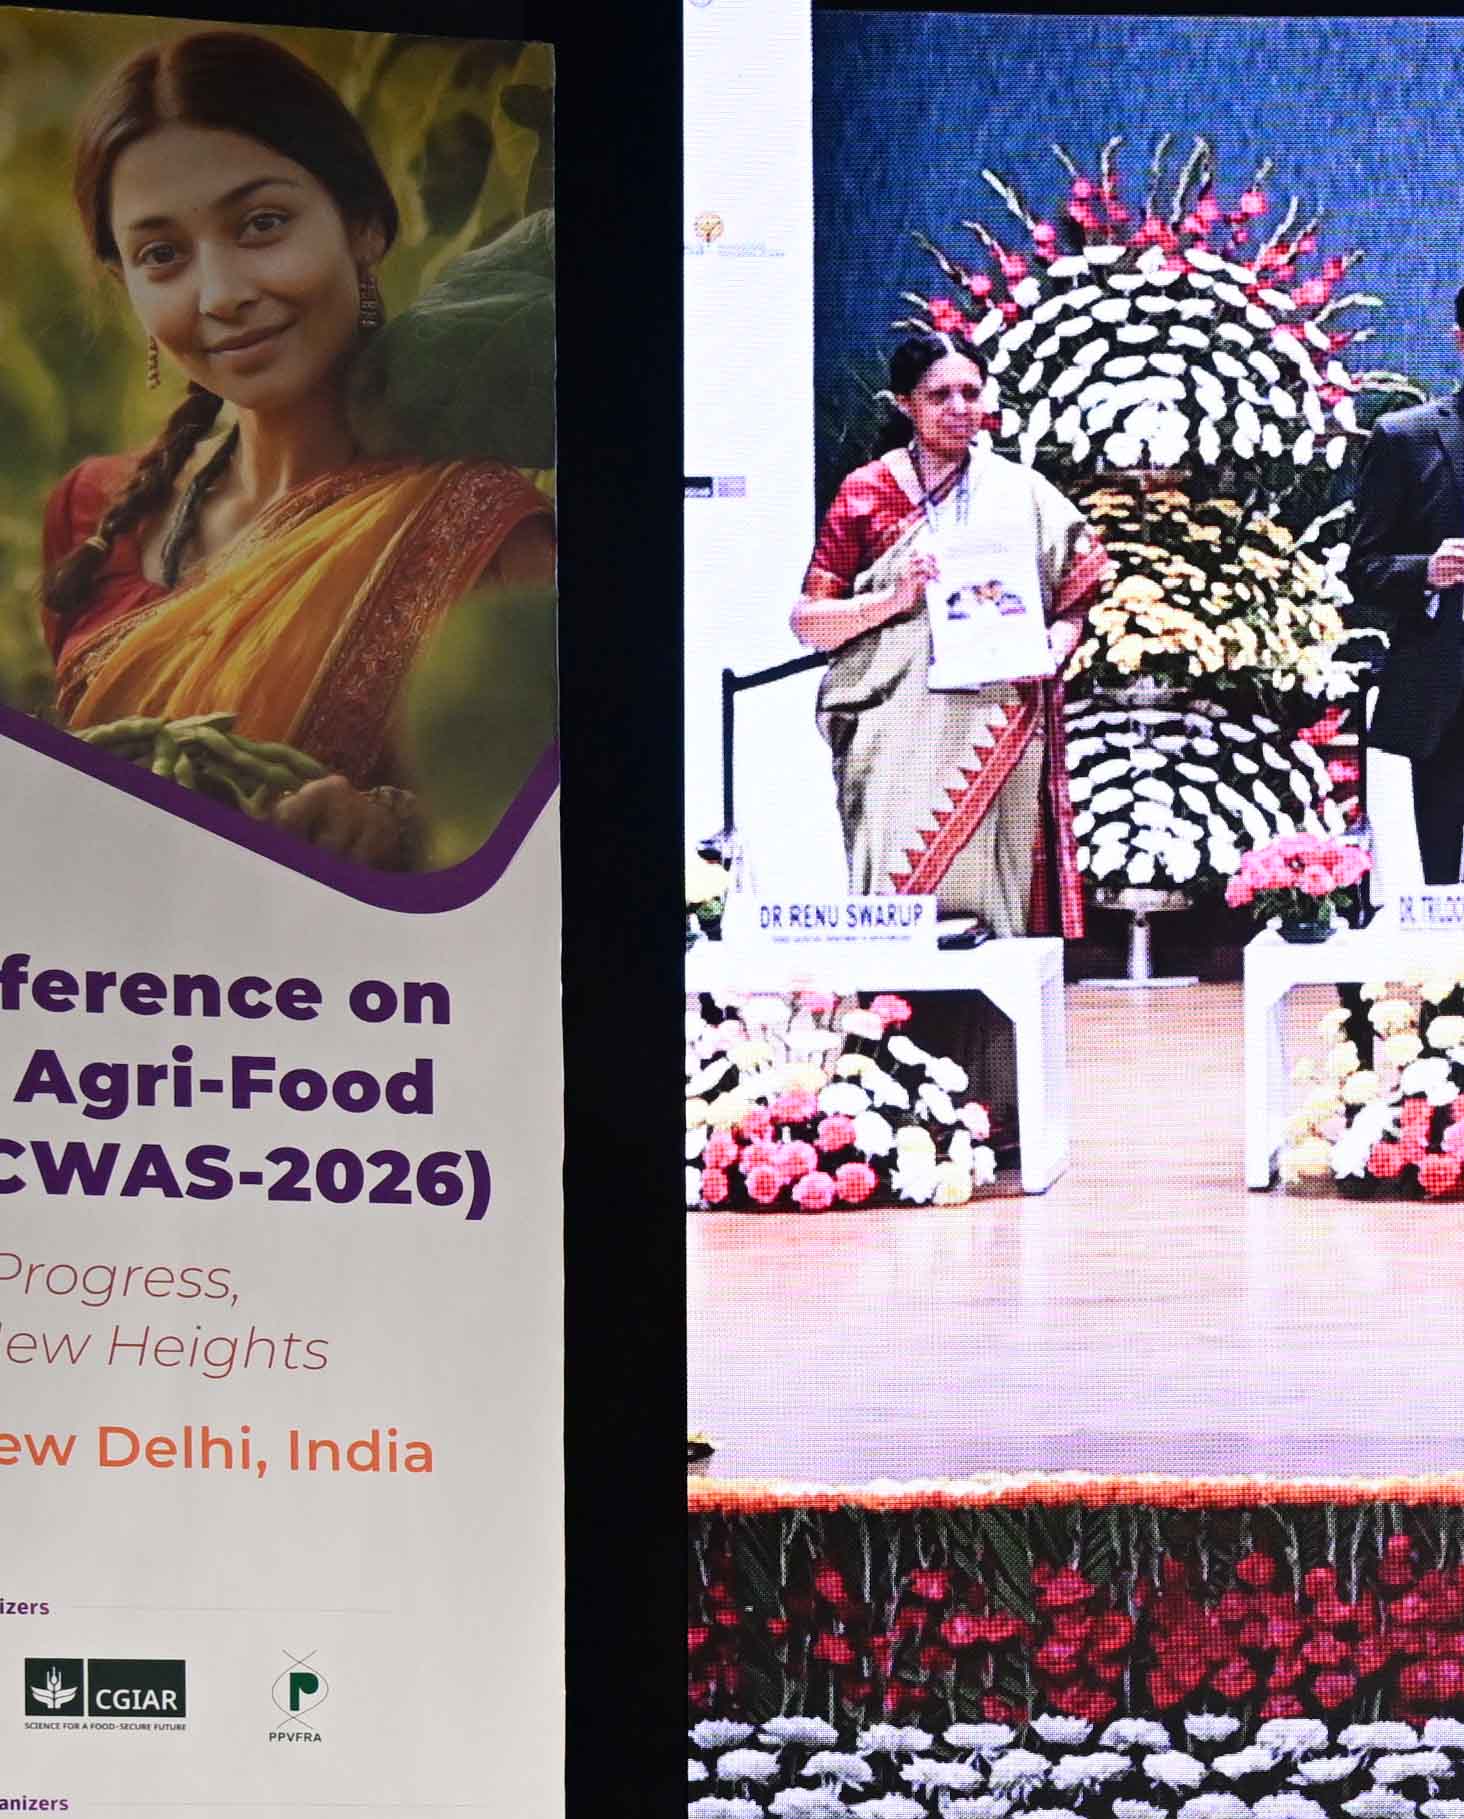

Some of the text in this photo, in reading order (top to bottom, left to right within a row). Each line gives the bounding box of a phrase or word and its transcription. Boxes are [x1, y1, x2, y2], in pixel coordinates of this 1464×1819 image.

[790, 905, 838, 928] RENU
[846, 903, 922, 928] SWARUP
[349, 980, 450, 1024] on
[14, 1045, 433, 1120] Agri-Food
[0, 1322, 328, 1379] ew Heights
[99, 1425, 266, 1478] Delhi,
[289, 1428, 432, 1472] India
[96, 1689, 177, 1710] CGIAR
[269, 1732, 321, 1742] PPVFRA
